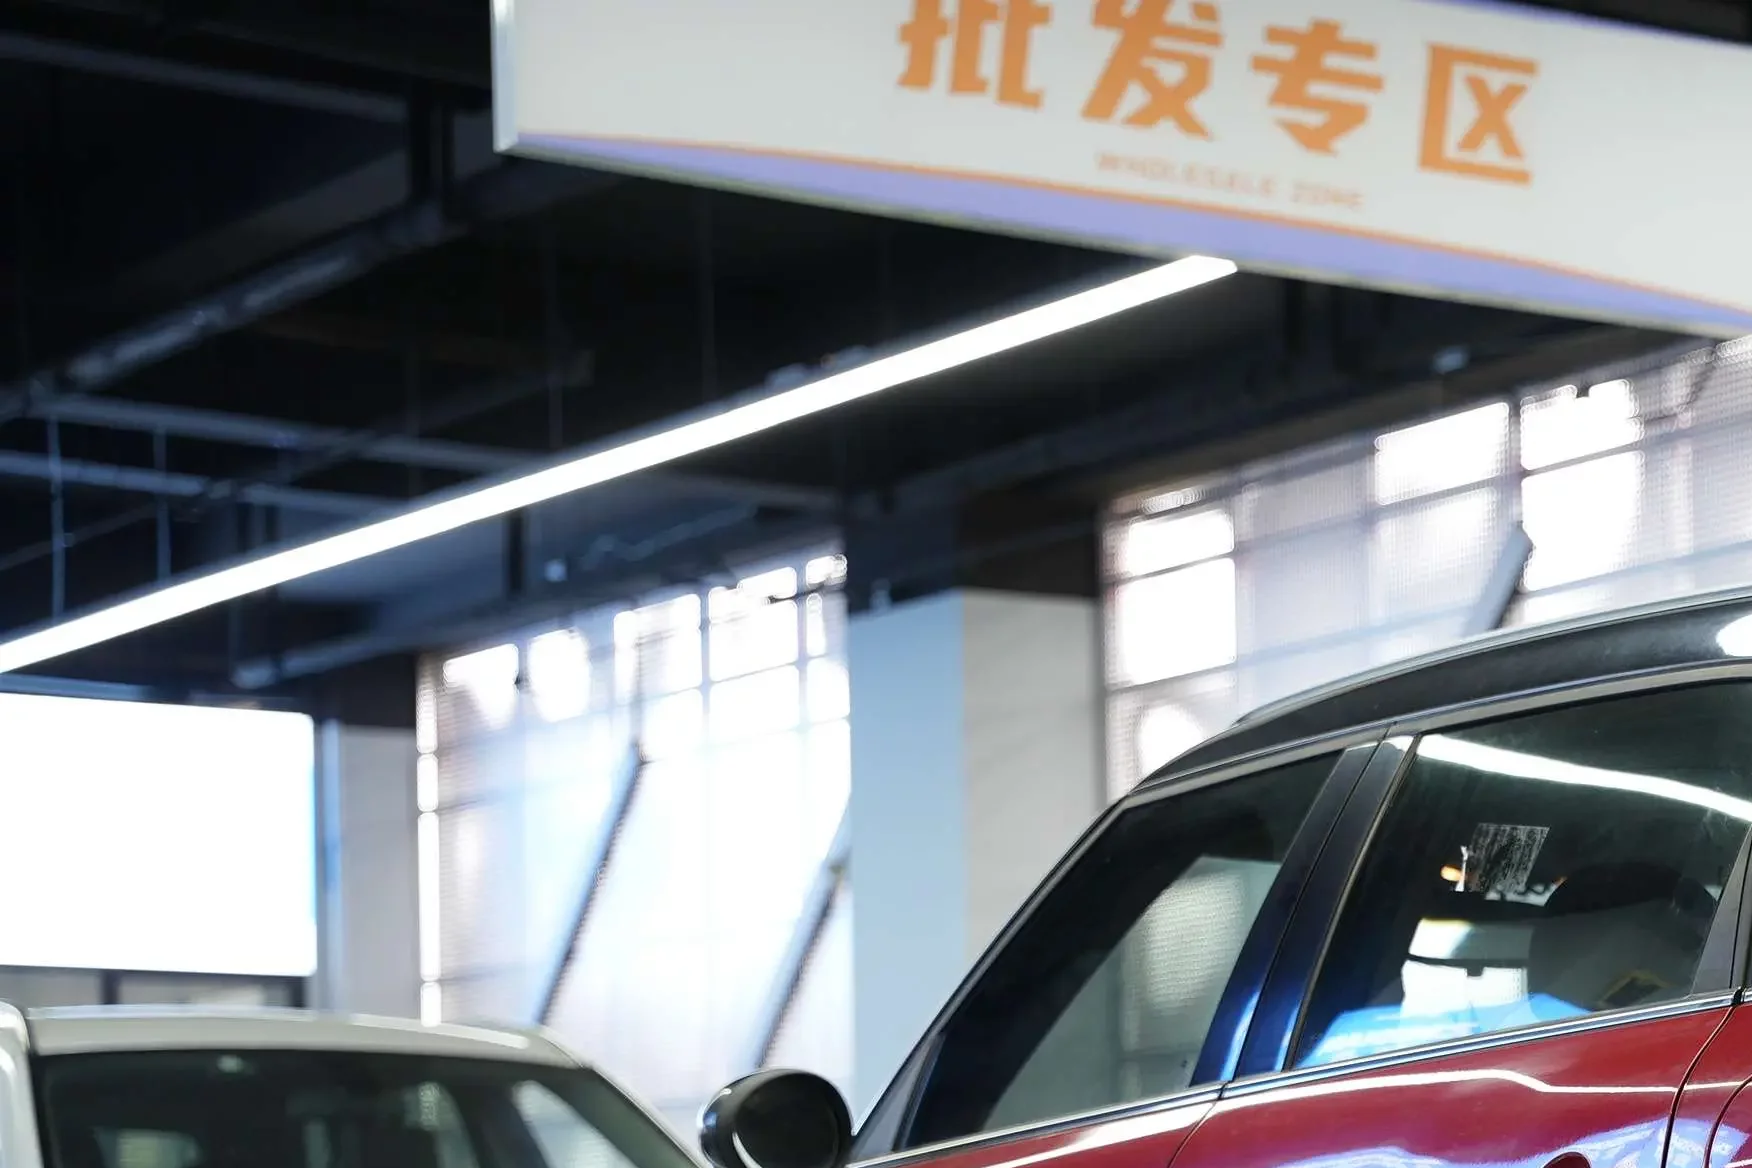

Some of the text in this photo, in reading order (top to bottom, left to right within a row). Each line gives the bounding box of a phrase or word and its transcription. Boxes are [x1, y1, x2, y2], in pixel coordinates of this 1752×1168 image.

[897, 0, 1539, 187] 批发专区
[1095, 152, 1278, 196] WHOLESALE
